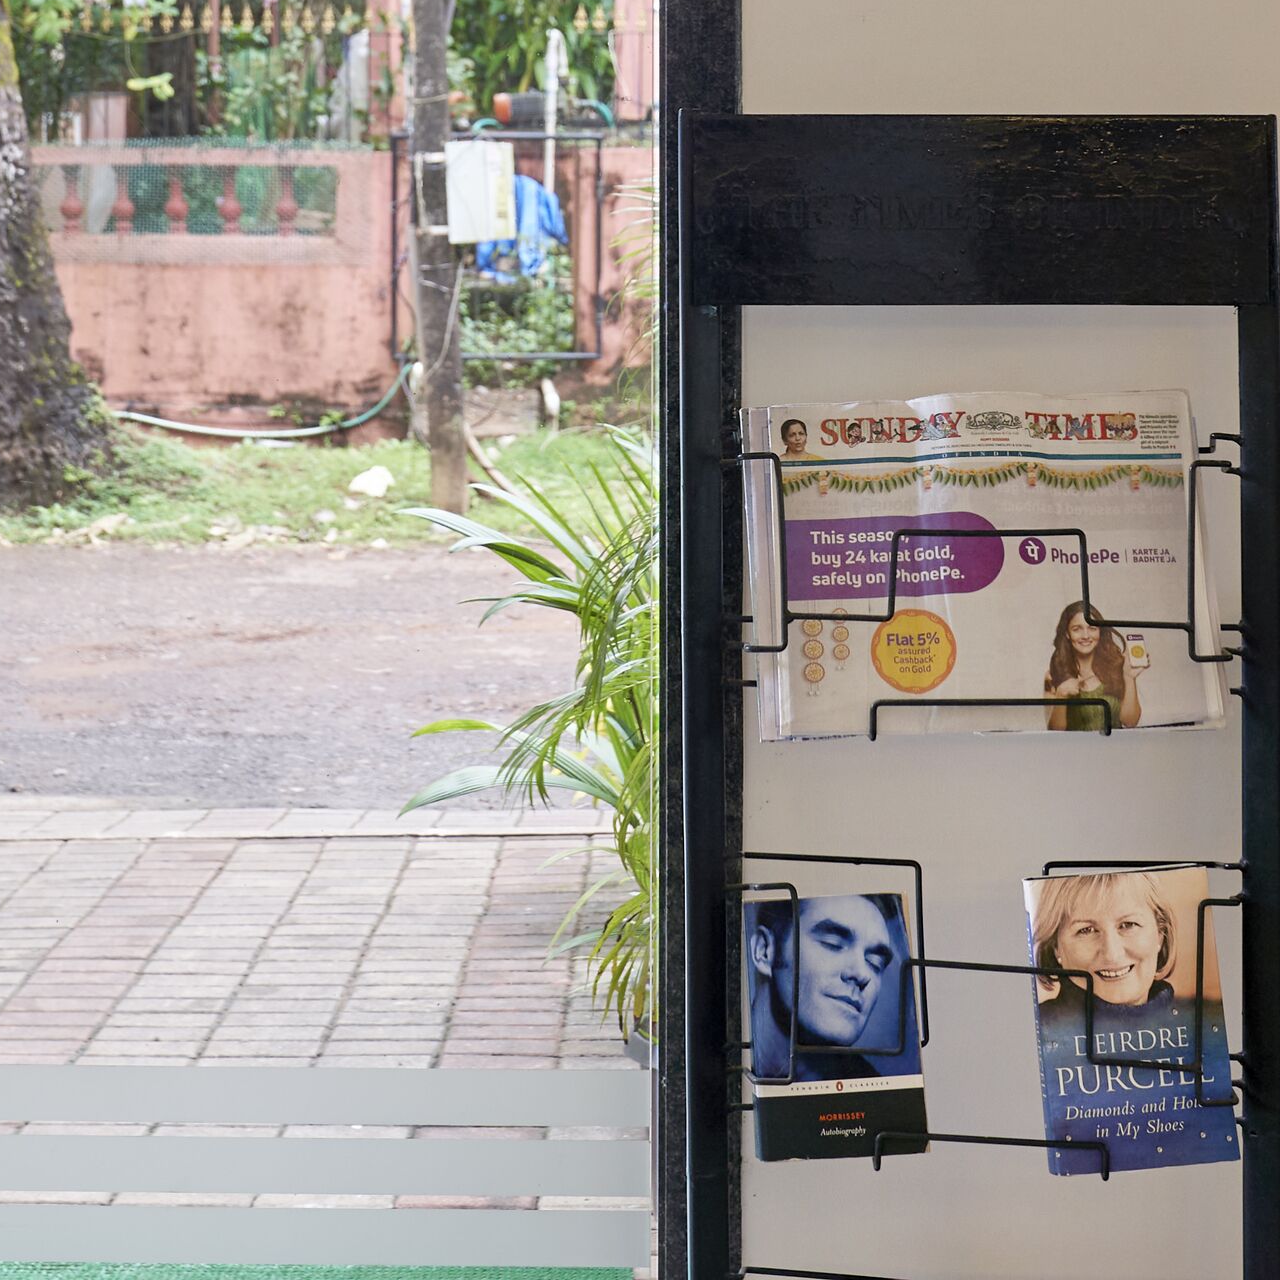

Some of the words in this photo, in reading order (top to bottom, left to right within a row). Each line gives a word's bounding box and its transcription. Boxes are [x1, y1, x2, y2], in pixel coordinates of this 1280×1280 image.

[810, 530, 845, 544] This
[848, 531, 909, 544] seaso,
[811, 552, 841, 568] buy
[845, 550, 867, 564] 24
[870, 549, 911, 563] karat
[914, 545, 955, 562] Gold,
[1132, 548, 1158, 556] KARTE
[1166, 556, 1177, 564] JA
[812, 571, 862, 588] safely
[866, 572, 886, 584] on
[886, 633, 915, 646] Flat
[917, 632, 940, 646] 5%
[898, 646, 931, 655] assured
[911, 665, 932, 673] Gold
[1074, 1026, 1189, 1056] DEIRDRE
[1066, 1101, 1136, 1120] Diamonds
[1141, 1101, 1166, 1114] and
[1173, 1096, 1209, 1111] Hol
[818, 1112, 865, 1121] MORRISSEY
[820, 1125, 866, 1137] Autobiography
[1096, 1125, 1109, 1138] in
[1116, 1122, 1140, 1138] My
[1146, 1119, 1185, 1134] Shoes
